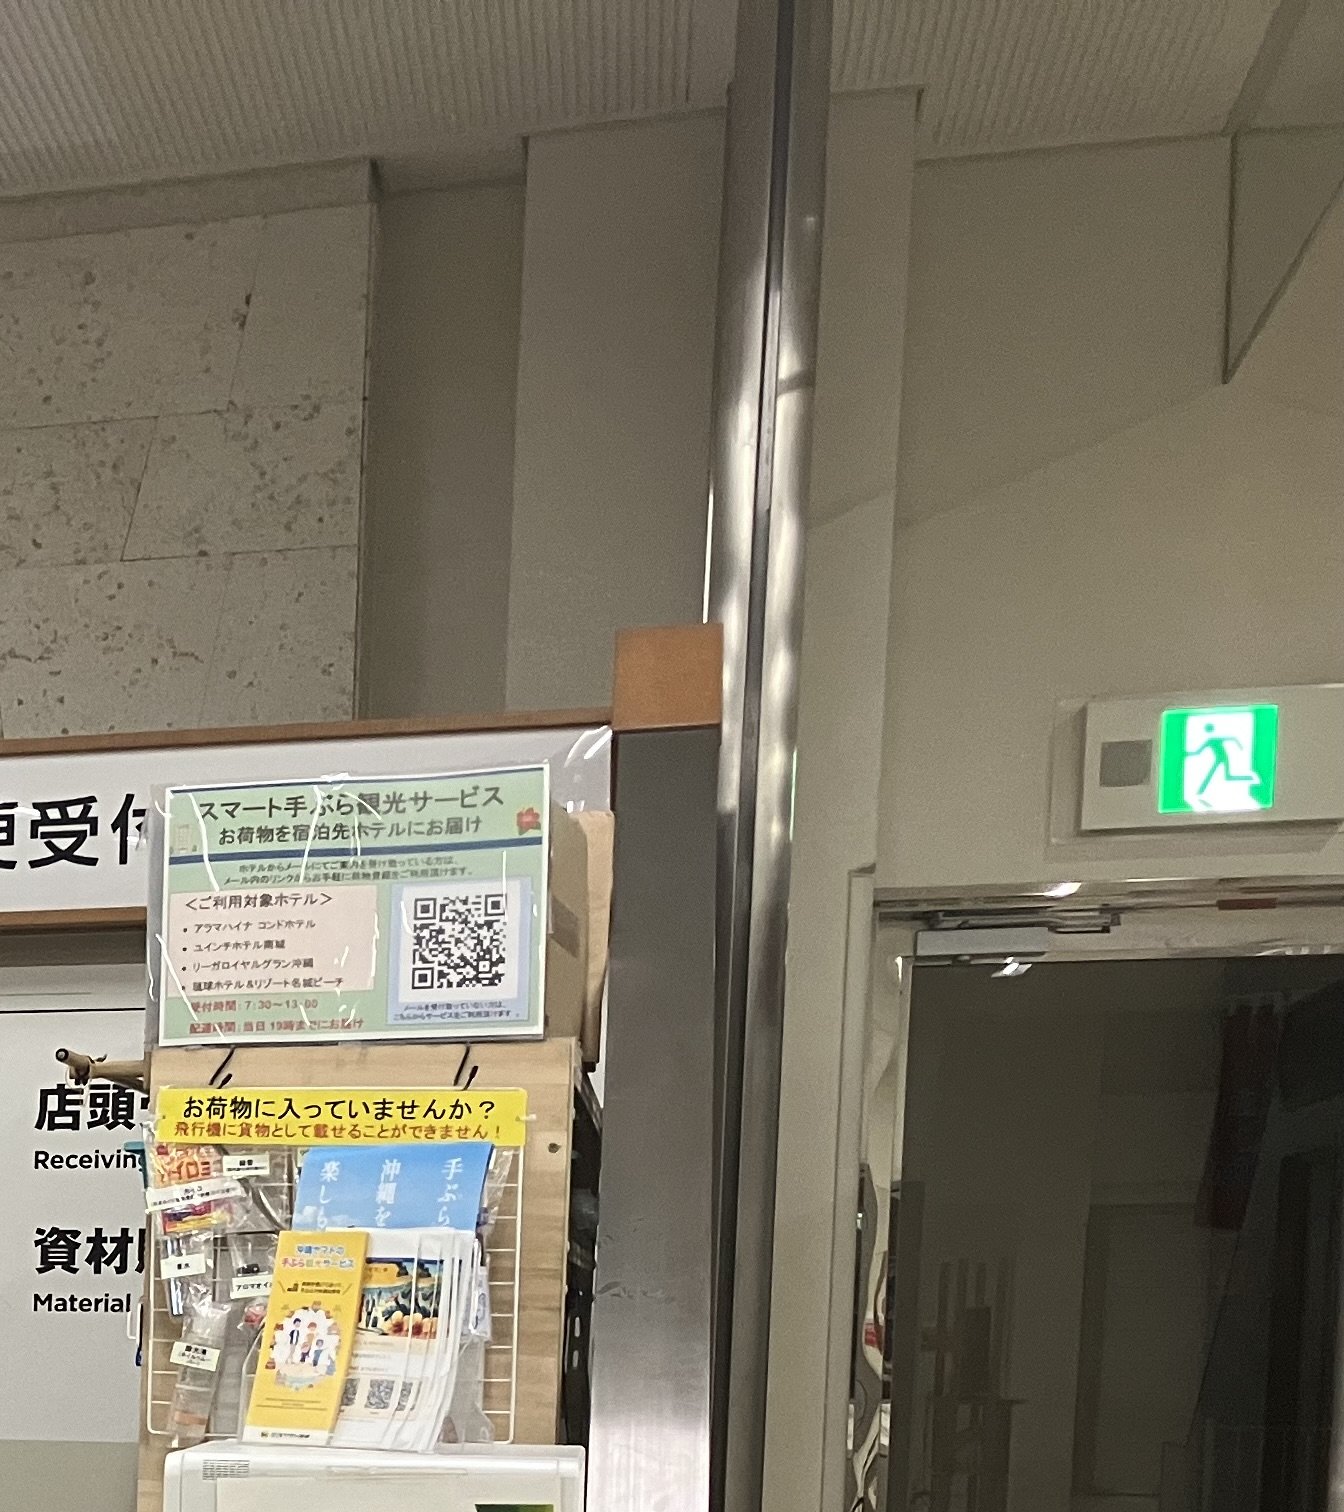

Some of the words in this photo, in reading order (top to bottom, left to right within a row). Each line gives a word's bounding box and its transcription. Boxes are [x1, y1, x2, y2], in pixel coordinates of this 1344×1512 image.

[200, 786, 504, 820] スマート手ぶら観光サービス
[218, 815, 482, 845] お荷物を宿泊先ホテルにお届け
[34, 1083, 149, 1131] 店頭
[184, 1096, 496, 1120] お荷物に入っていませんか？
[174, 1122, 501, 1140] 飛行機に貨物として載せることができません！
[375, 1158, 402, 1224] 沖縄を
[34, 1227, 147, 1275] 資材
[33, 1293, 131, 1313] Material
